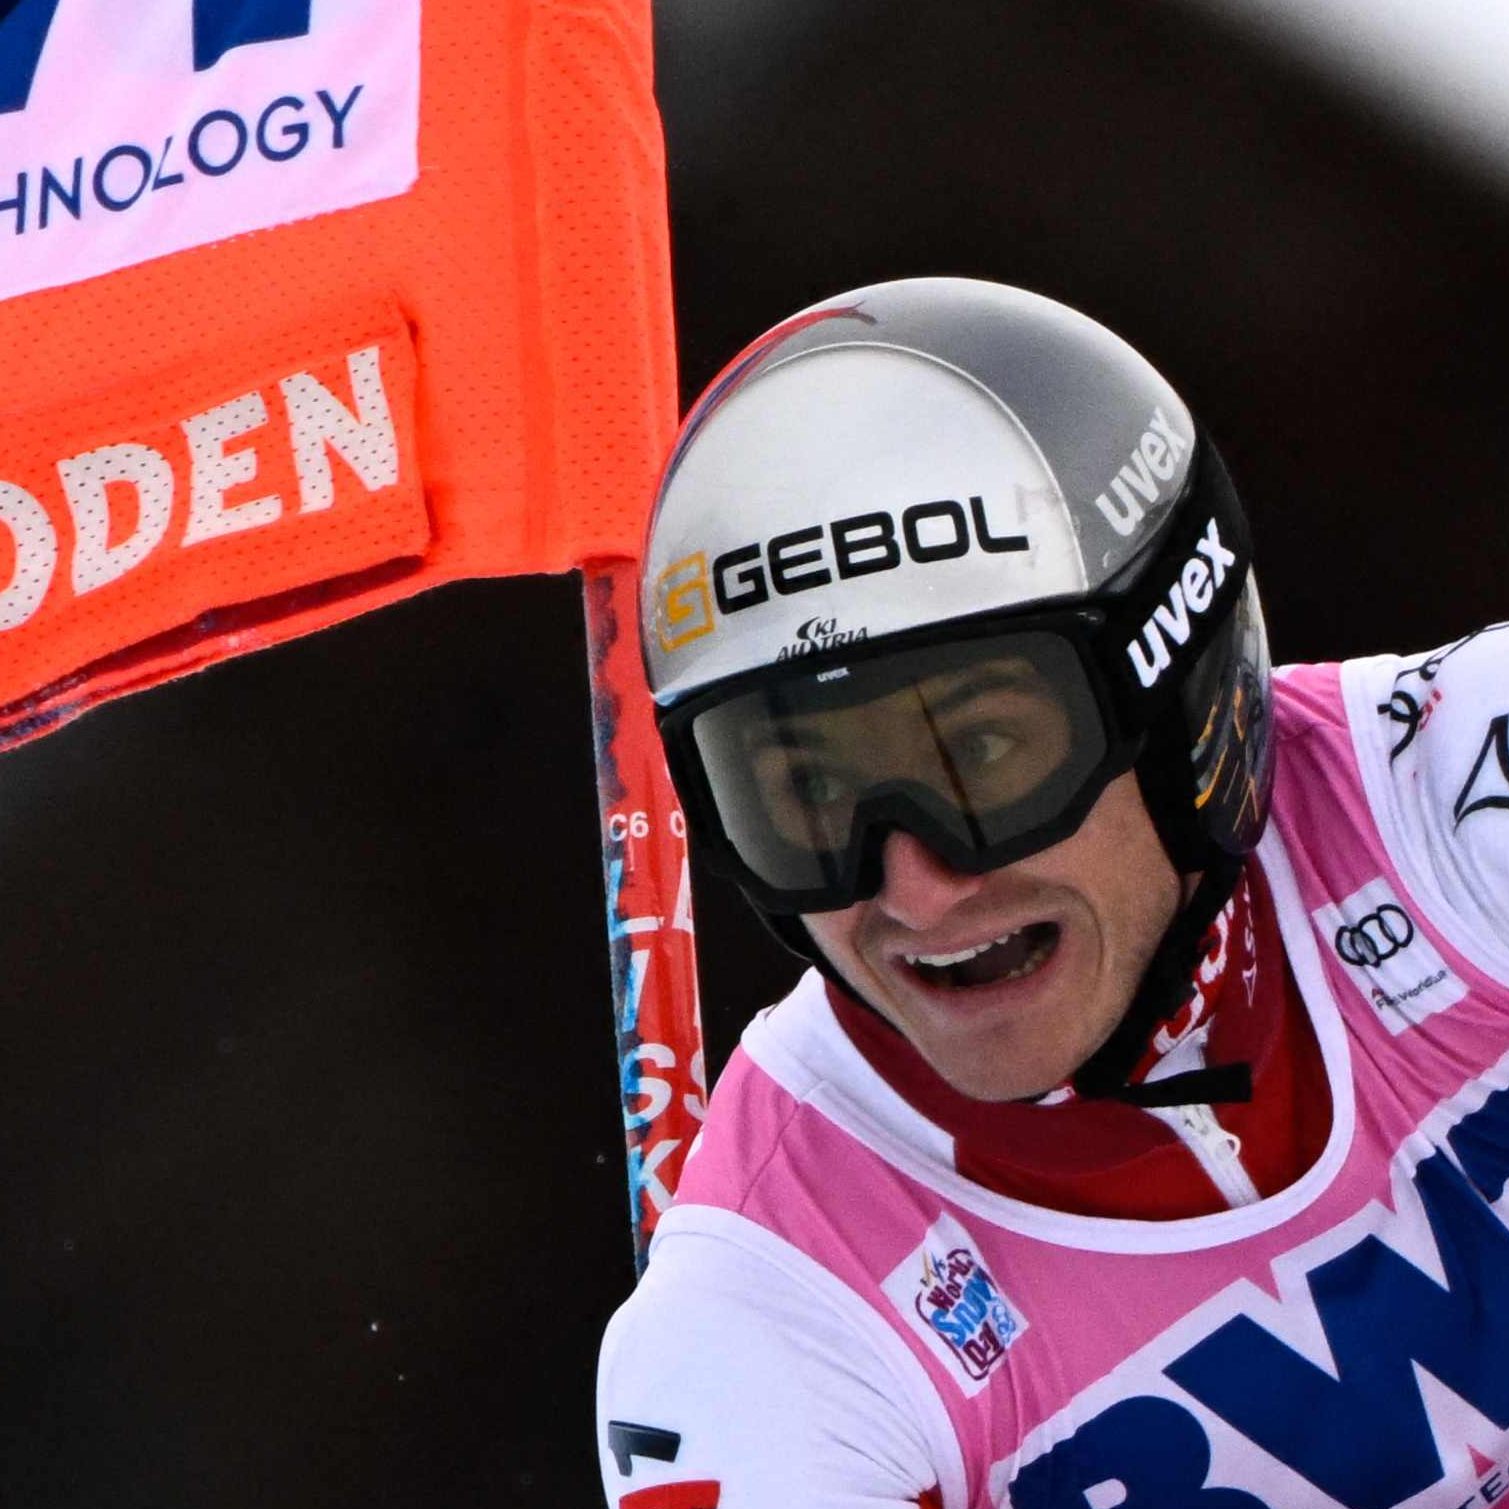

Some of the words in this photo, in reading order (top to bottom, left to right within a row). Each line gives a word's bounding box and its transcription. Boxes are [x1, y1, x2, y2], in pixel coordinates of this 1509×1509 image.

[1094, 407, 1190, 537] uvex
[711, 495, 1030, 615] GEBOL
[1126, 518, 1236, 690] uvex
